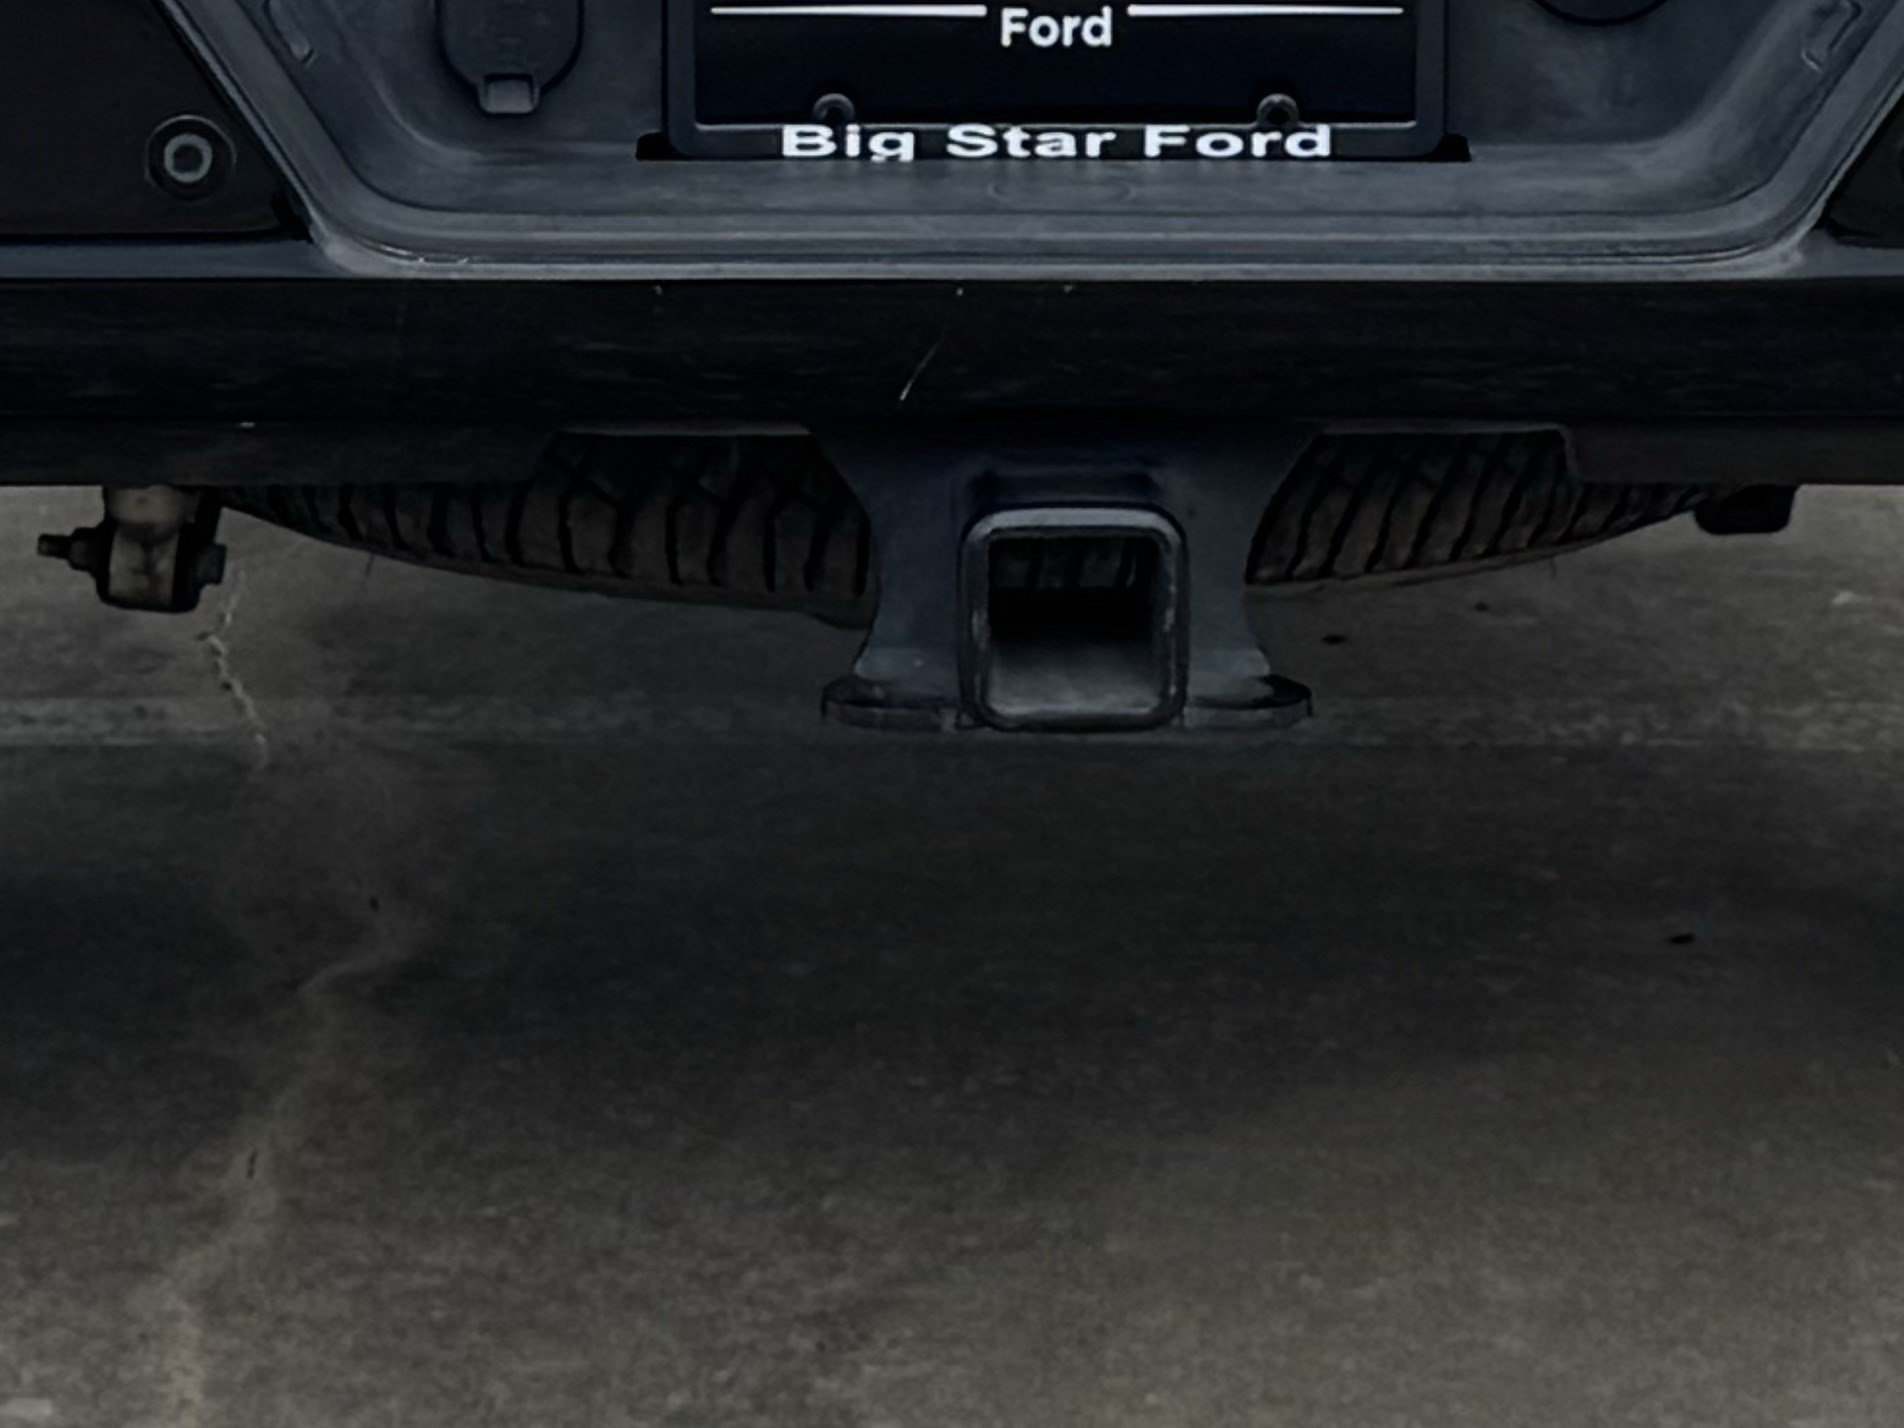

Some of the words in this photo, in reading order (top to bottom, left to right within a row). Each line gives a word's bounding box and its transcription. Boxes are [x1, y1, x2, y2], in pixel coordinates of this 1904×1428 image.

[1002, 6, 1111, 46] Ford
[781, 124, 916, 162] Big
[946, 124, 1116, 157] Star
[1144, 124, 1332, 158] Ford
